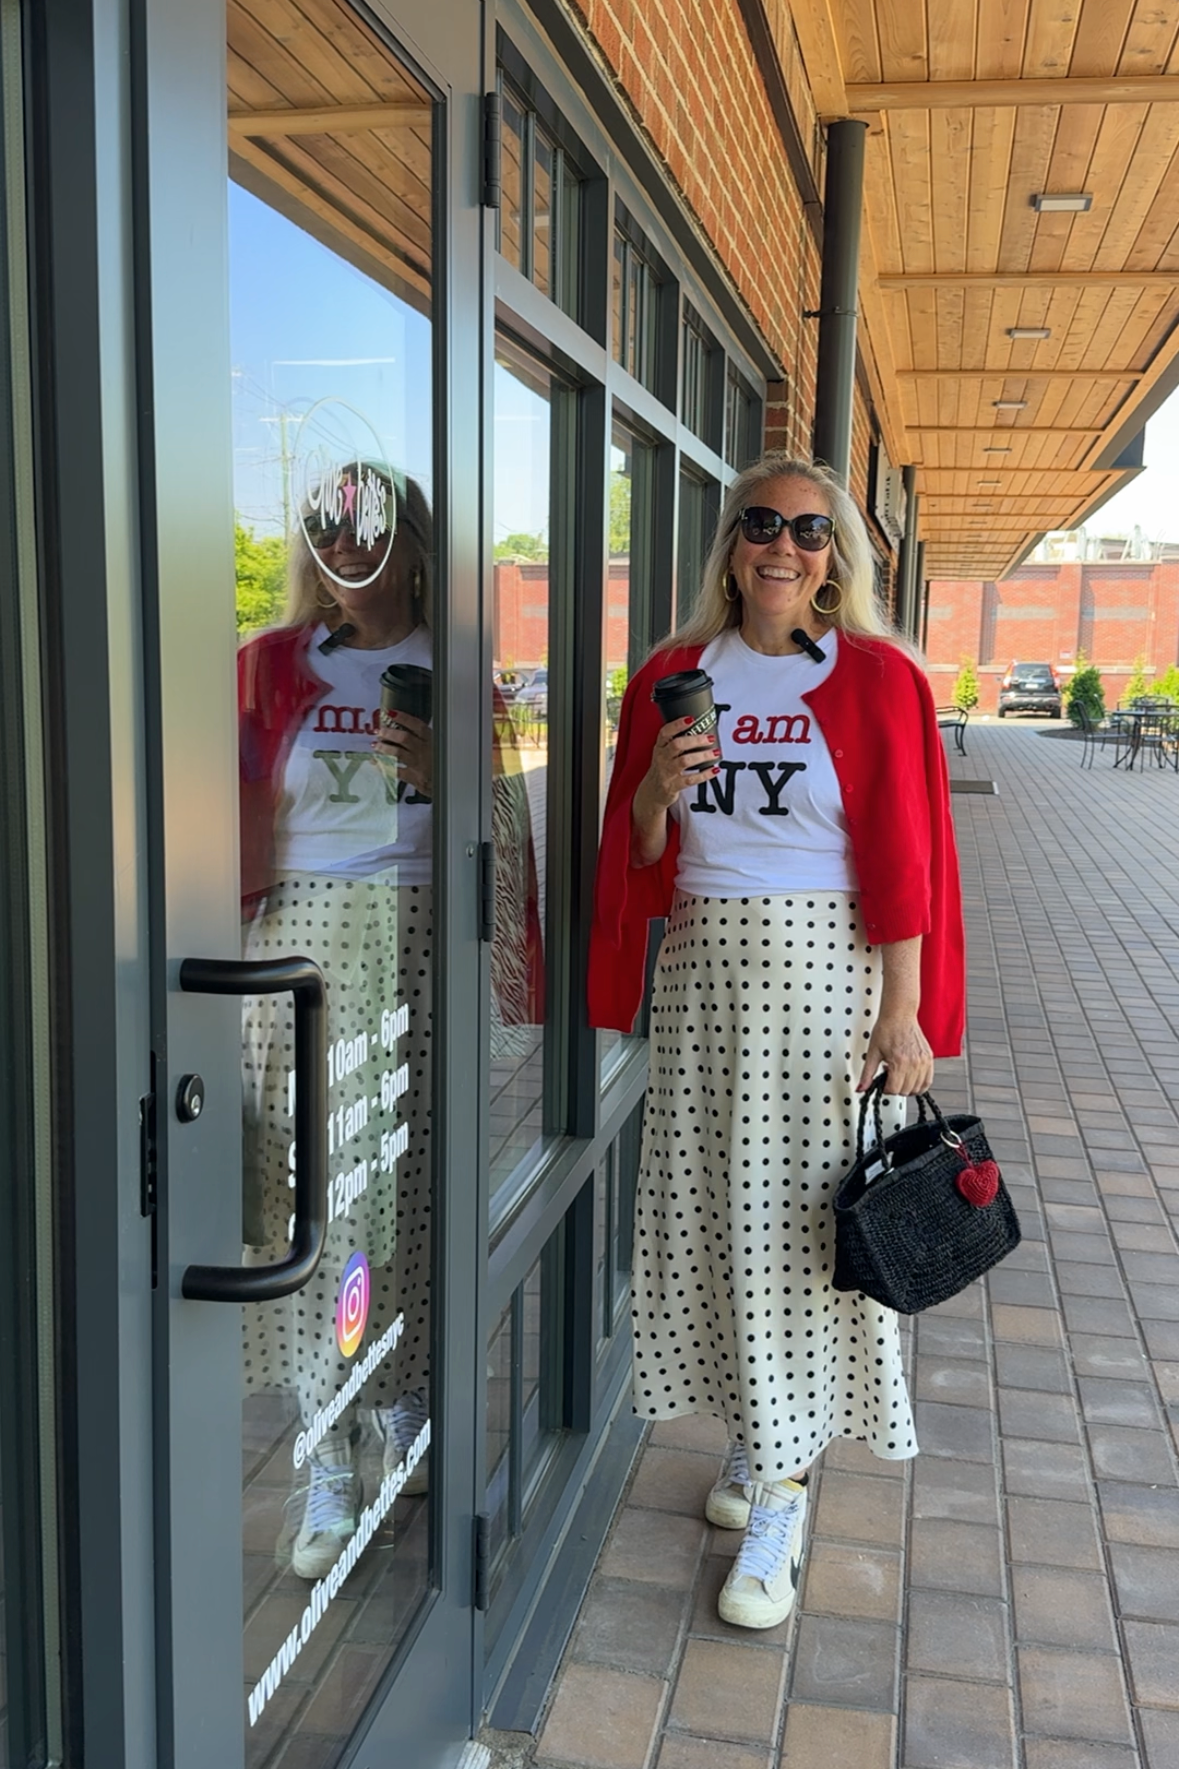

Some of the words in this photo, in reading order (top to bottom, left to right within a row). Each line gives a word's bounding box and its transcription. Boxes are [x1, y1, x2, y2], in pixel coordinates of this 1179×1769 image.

[731, 713, 812, 744] am
[689, 760, 807, 816] NY
[327, 1031, 368, 1088] 10am
[380, 1003, 409, 1052] 6pm
[327, 1095, 368, 1156] 11am
[380, 1062, 409, 1113] 6pm
[327, 1159, 368, 1224] 12pm
[380, 1121, 409, 1175] 5pm
[293, 1312, 404, 1469] @oliveandbettesnyc
[248, 1418, 431, 1727] www.oliveandbettes.com
